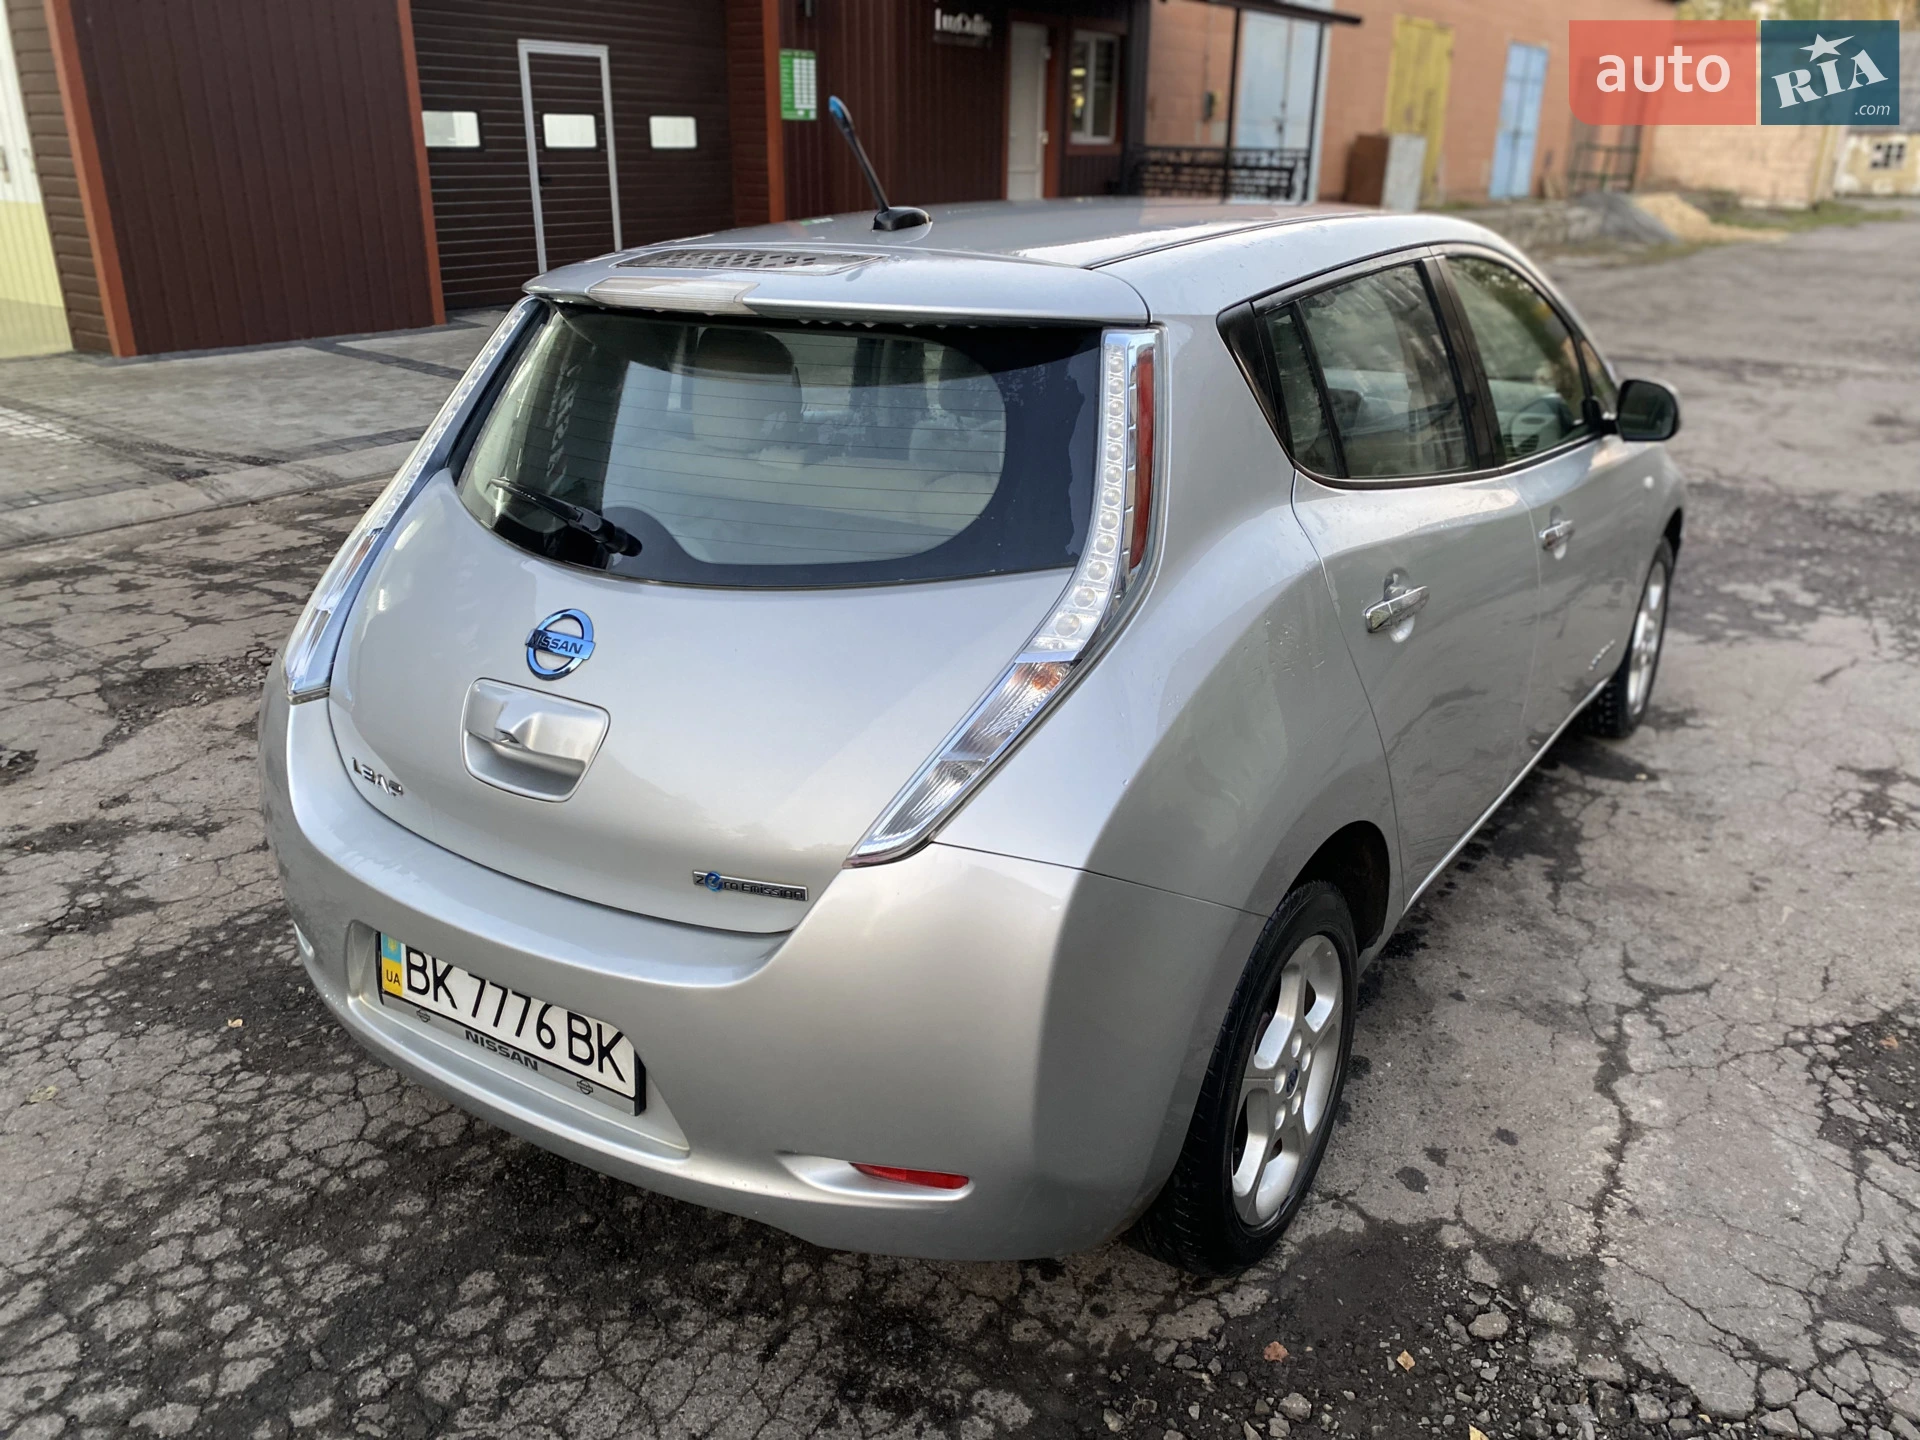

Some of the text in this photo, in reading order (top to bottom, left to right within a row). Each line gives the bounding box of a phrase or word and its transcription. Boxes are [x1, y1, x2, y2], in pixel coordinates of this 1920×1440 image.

[529, 633, 584, 655] NISSAN
[386, 969, 401, 985] UA
[405, 945, 626, 1083] BK 7776 BK
[465, 1030, 539, 1071] NISSAN
